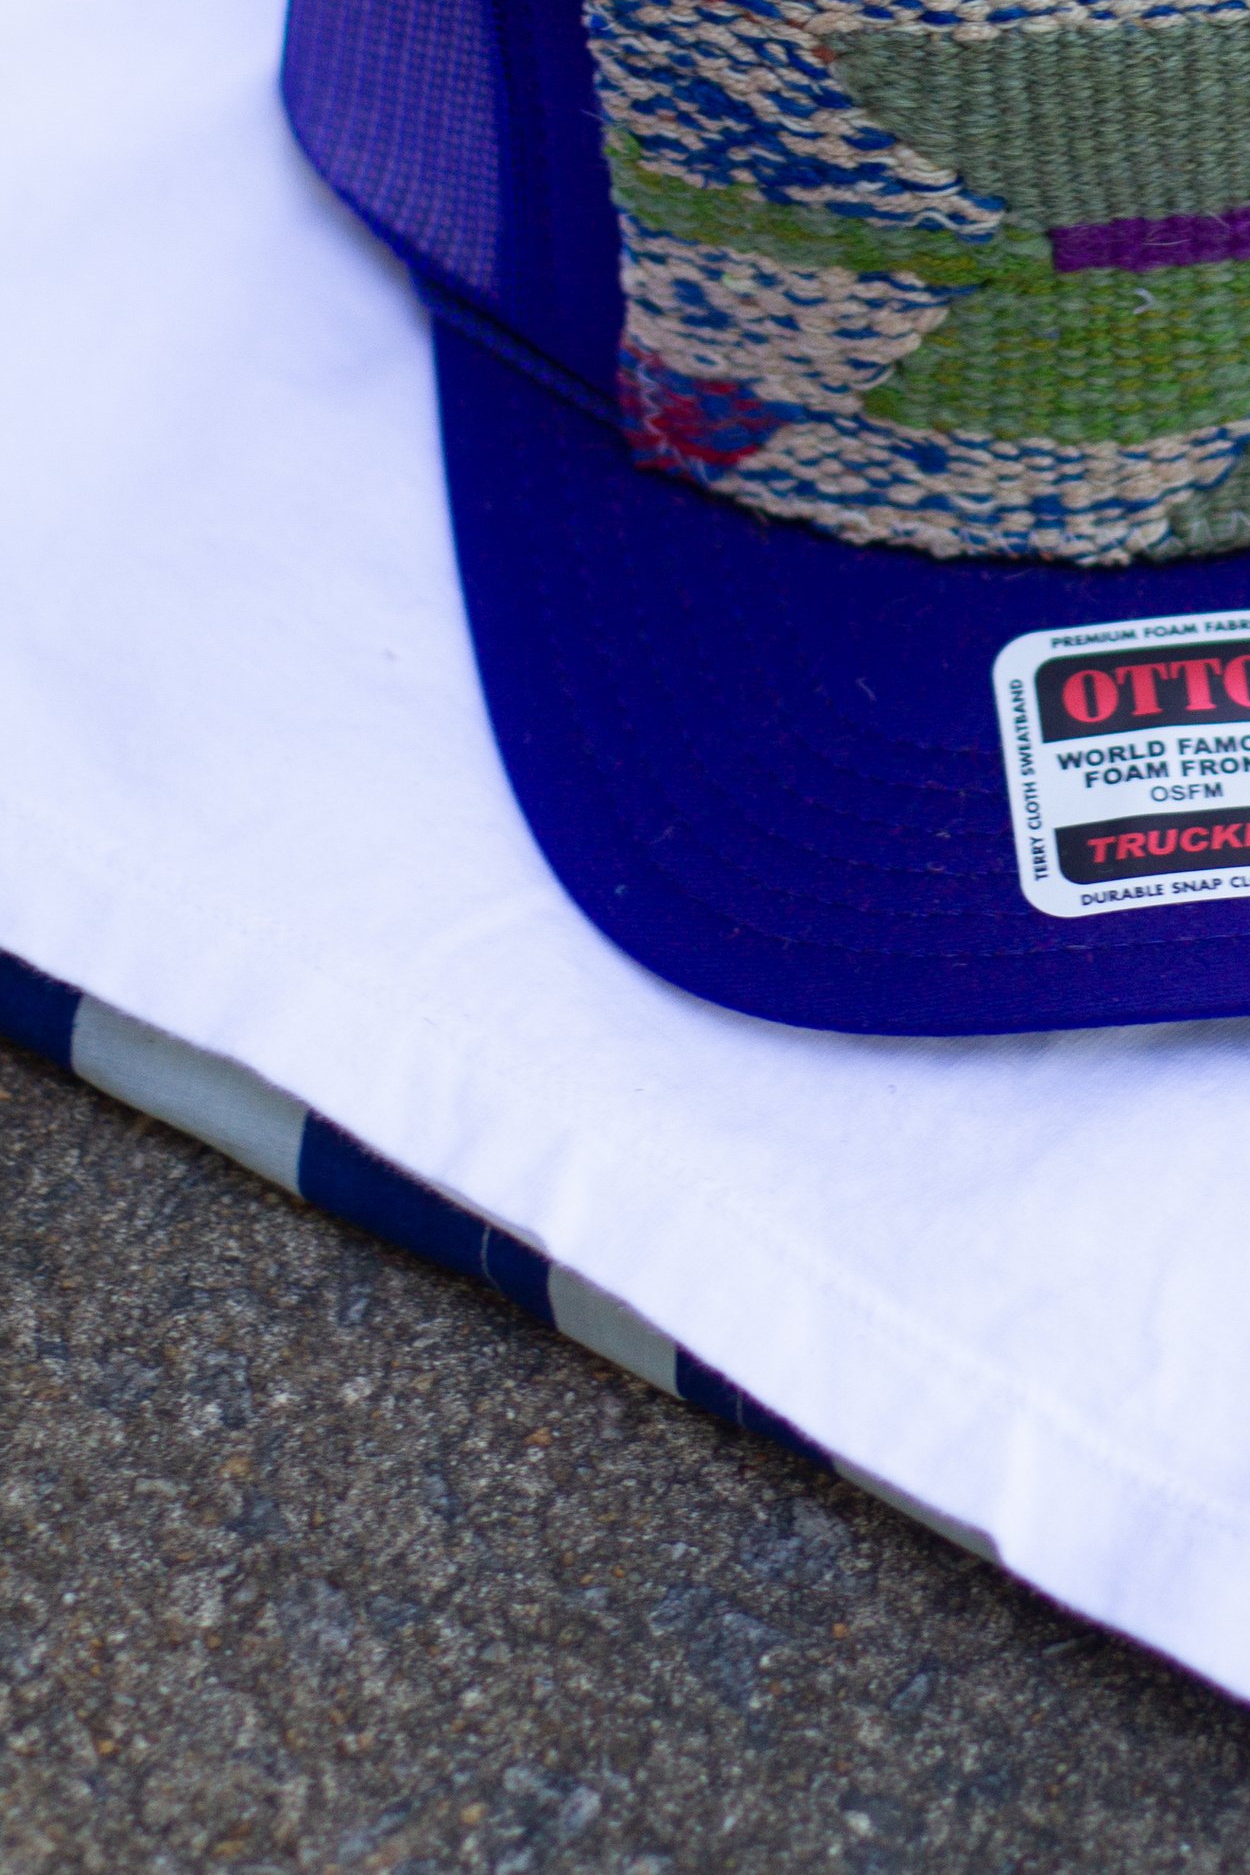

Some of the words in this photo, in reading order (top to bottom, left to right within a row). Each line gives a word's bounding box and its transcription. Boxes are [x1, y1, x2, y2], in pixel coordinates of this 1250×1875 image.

[1050, 628, 1137, 649] PREMIUM
[1144, 623, 1198, 638] FOAM
[1009, 678, 1035, 777] SWEATBAND
[1056, 739, 1166, 770] WORLD
[1084, 760, 1170, 789] FOAM
[1022, 781, 1043, 831] CLOTH
[1150, 781, 1224, 802] OSFM
[1029, 835, 1048, 882] TERRY
[1080, 883, 1165, 907] DURABLE
[1172, 877, 1223, 895] SNAP
